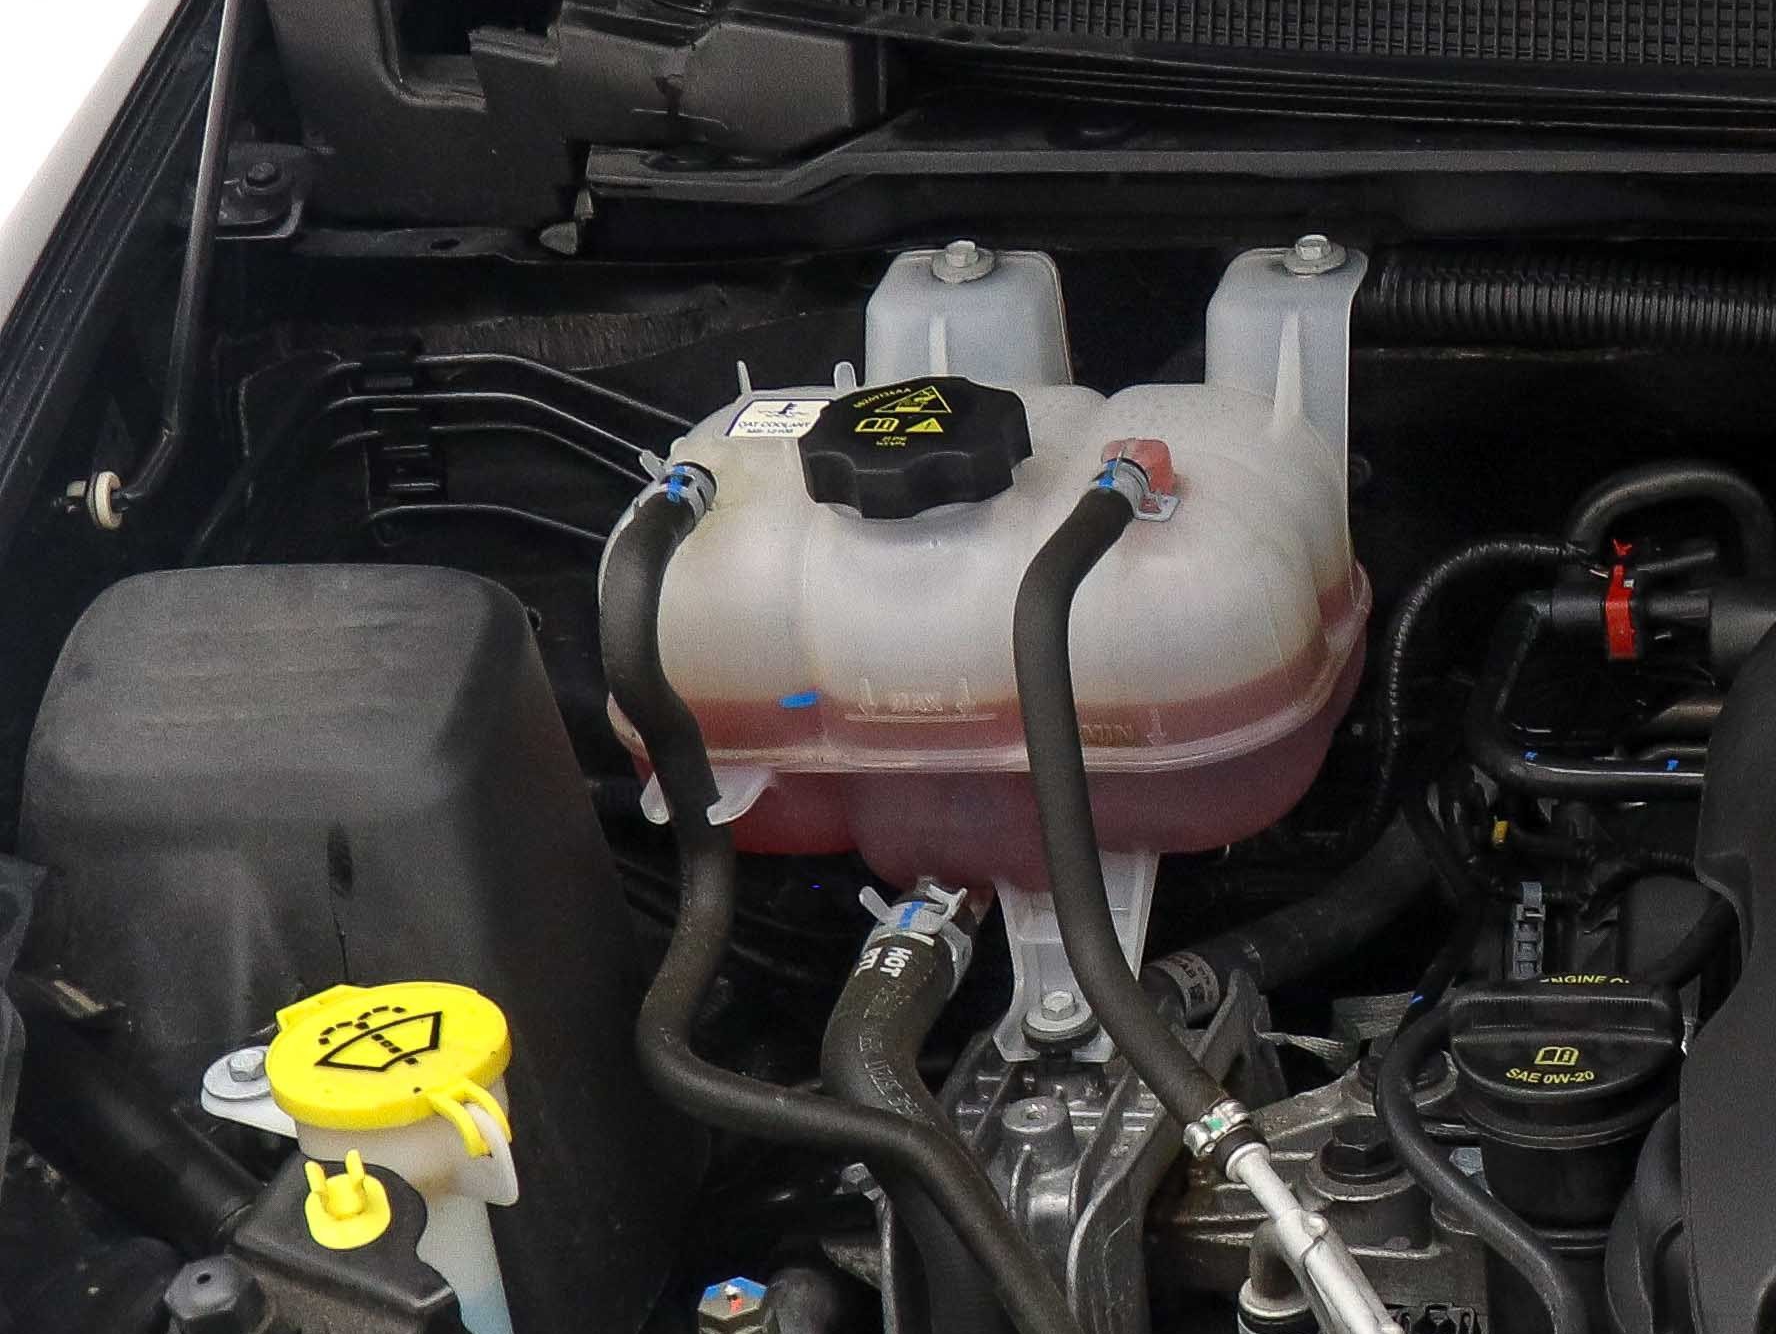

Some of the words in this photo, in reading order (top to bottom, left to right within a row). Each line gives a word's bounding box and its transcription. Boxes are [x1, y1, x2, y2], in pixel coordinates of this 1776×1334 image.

[879, 946, 913, 978] HOT
[1505, 1067, 1541, 1084] SAE
[1543, 1070, 1595, 1084] 0W-20
